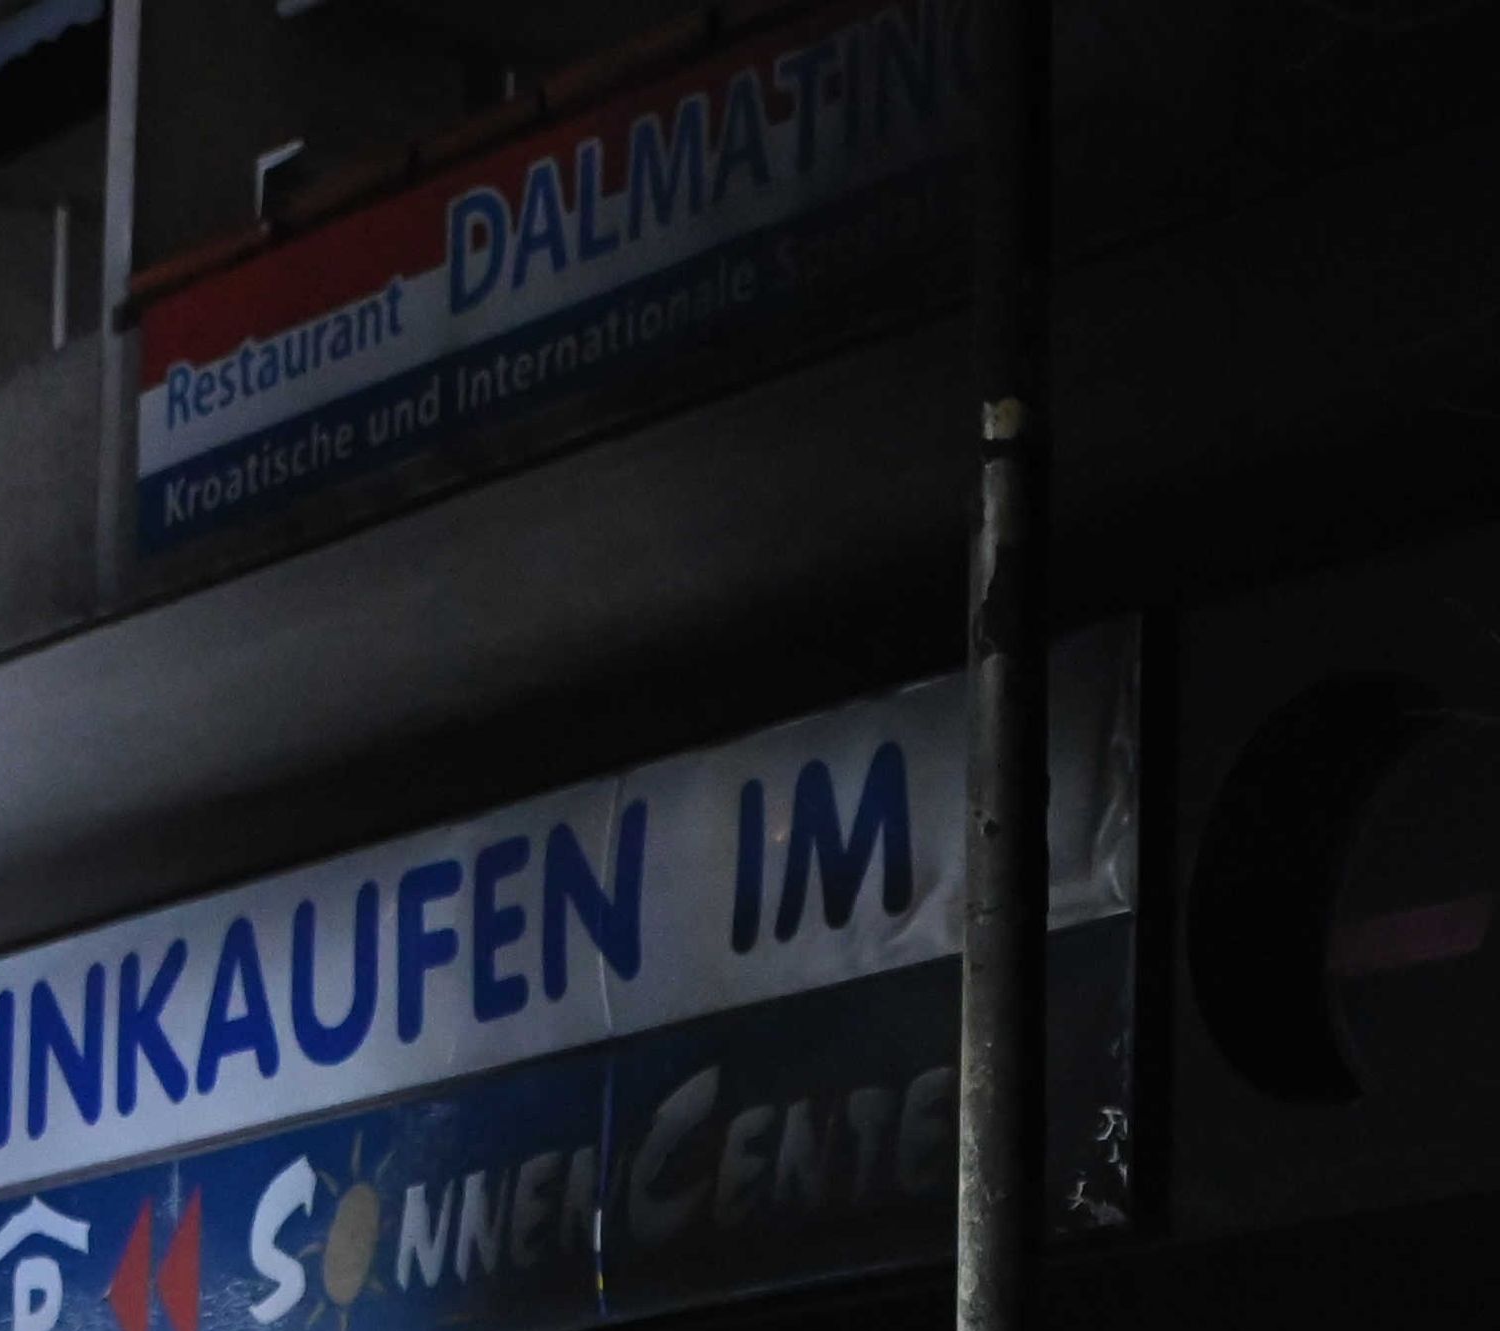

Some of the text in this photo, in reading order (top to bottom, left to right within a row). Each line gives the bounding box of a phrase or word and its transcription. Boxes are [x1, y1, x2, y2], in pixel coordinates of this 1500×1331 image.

[163, 253, 757, 528] Kroatische und Internationale
[167, 283, 402, 428] Restaurant
[731, 740, 914, 954] IM
[628, 1064, 959, 1245] CENTE
